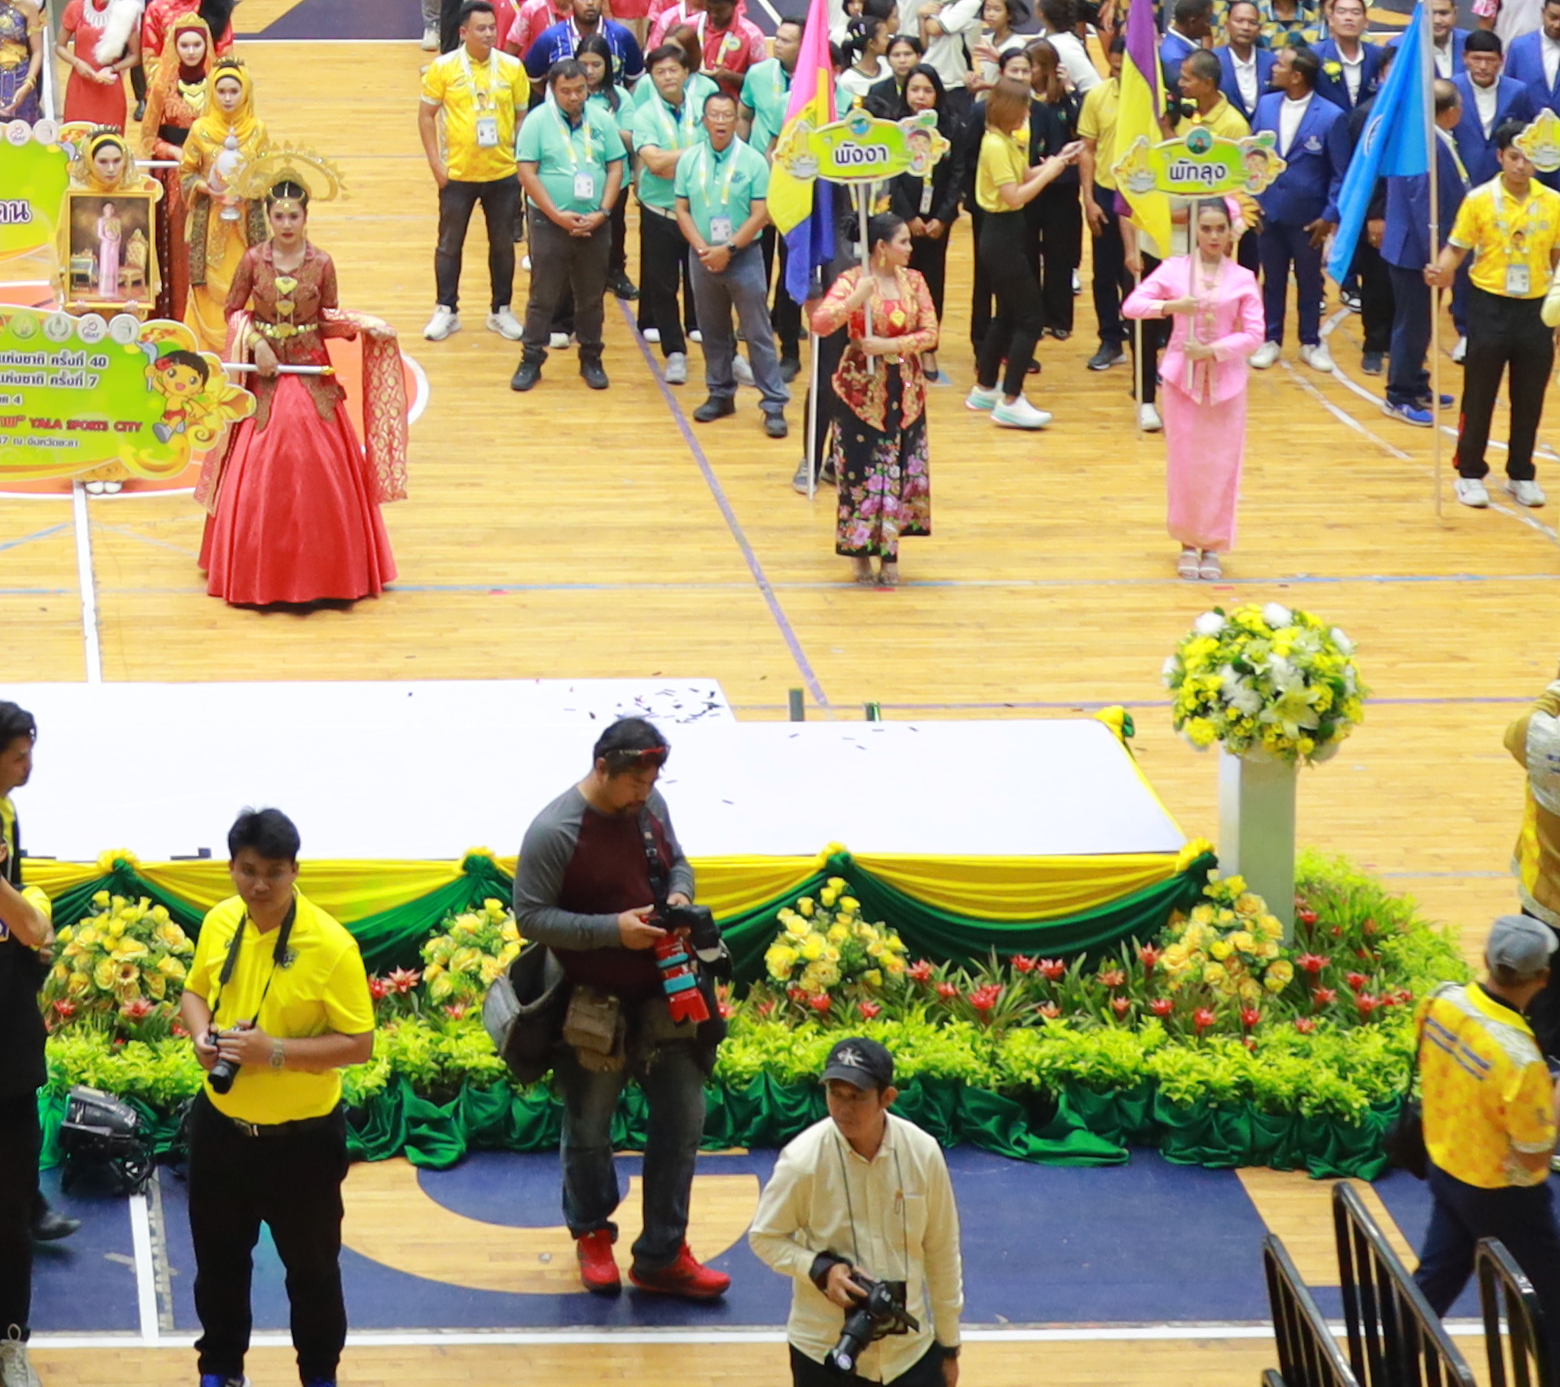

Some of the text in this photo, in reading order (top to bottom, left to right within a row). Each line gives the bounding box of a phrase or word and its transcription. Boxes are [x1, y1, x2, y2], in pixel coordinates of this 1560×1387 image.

[835, 143, 888, 164] พังงา
[1169, 160, 1226, 185] พัทลุง
[51, 349, 84, 367] ครั้งที่
[89, 356, 108, 367] 40
[50, 370, 84, 387] ครั้งที่
[89, 376, 97, 387] 7
[12, 395, 21, 405] 4
[113, 421, 143, 432] CITY
